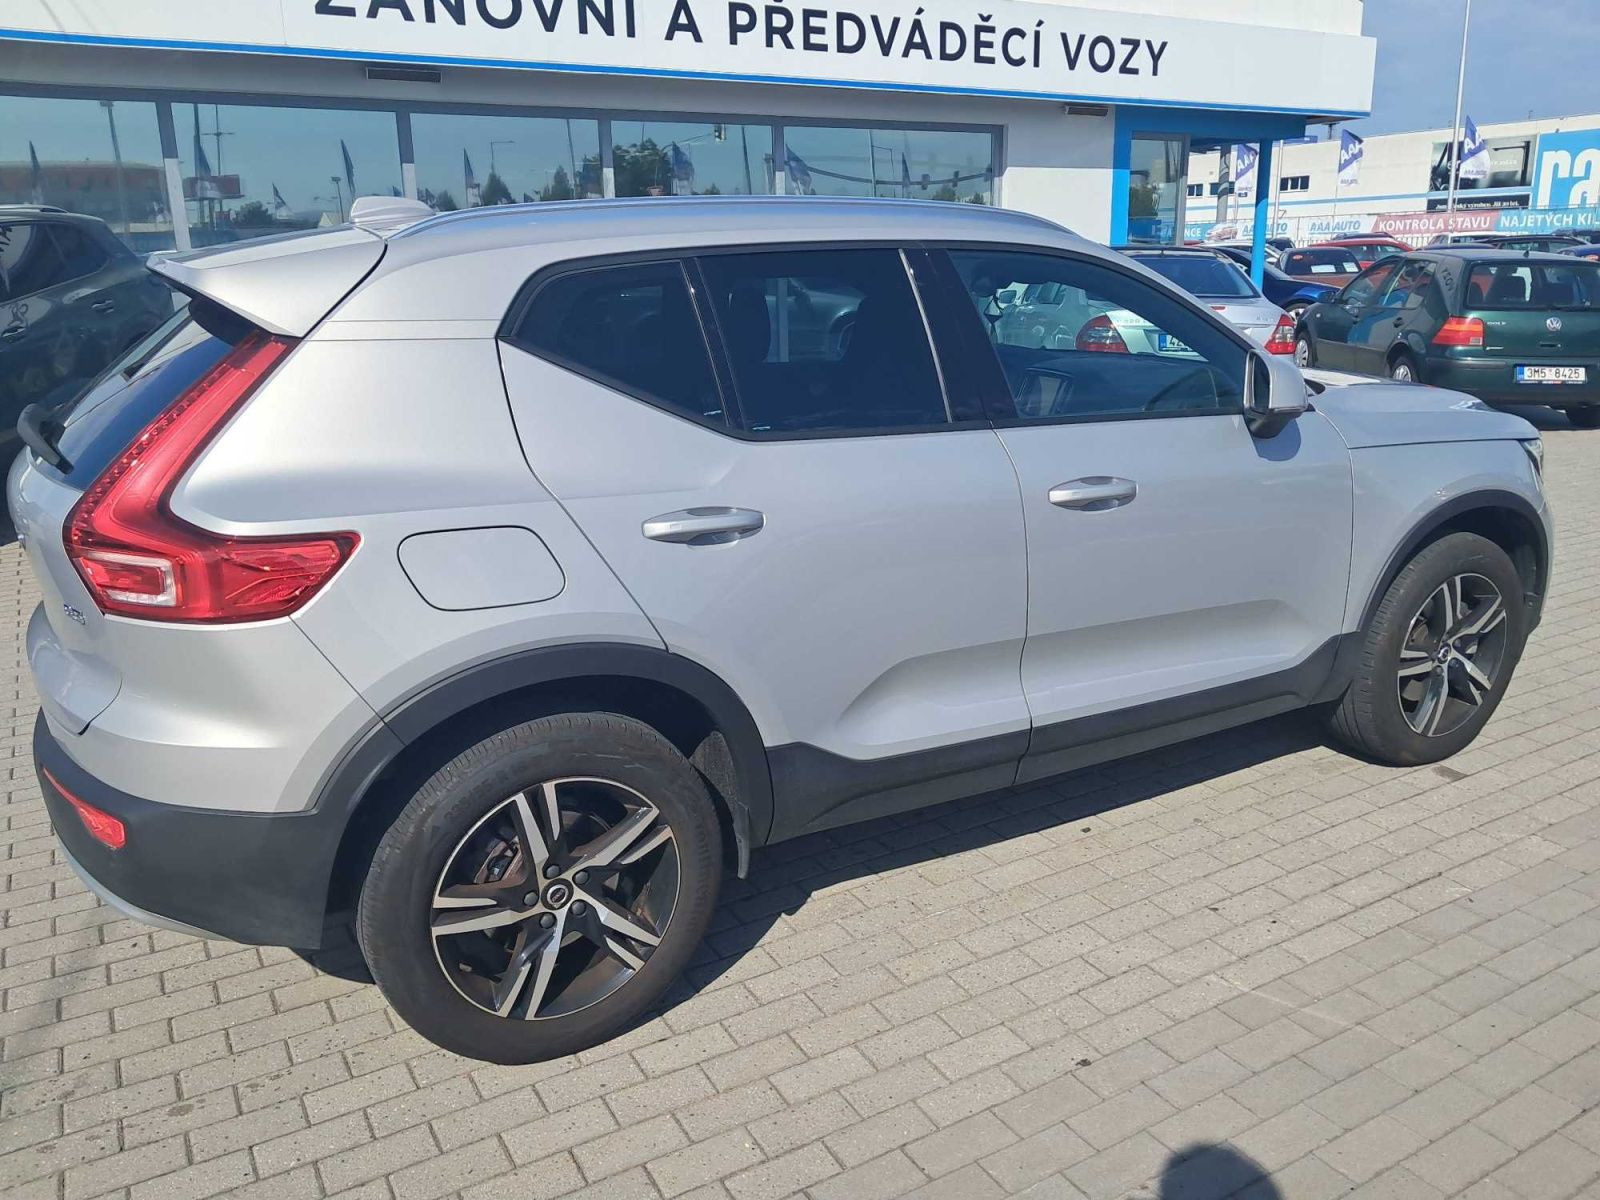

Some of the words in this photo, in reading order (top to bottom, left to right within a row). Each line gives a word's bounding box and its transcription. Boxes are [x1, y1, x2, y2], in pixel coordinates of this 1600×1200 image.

[664, 0, 703, 43] A
[728, 0, 1045, 68] PŘEDVÁDĚCÍ
[1060, 31, 1169, 77] VOZY
[1331, 220, 1361, 231] AUTO
[1379, 218, 1444, 232] KONTROLA
[1448, 216, 1490, 230] STAVU
[1500, 211, 1573, 227] NAJETÝCH
[1527, 367, 1547, 379] 3M5
[1554, 367, 1580, 379] 8425
